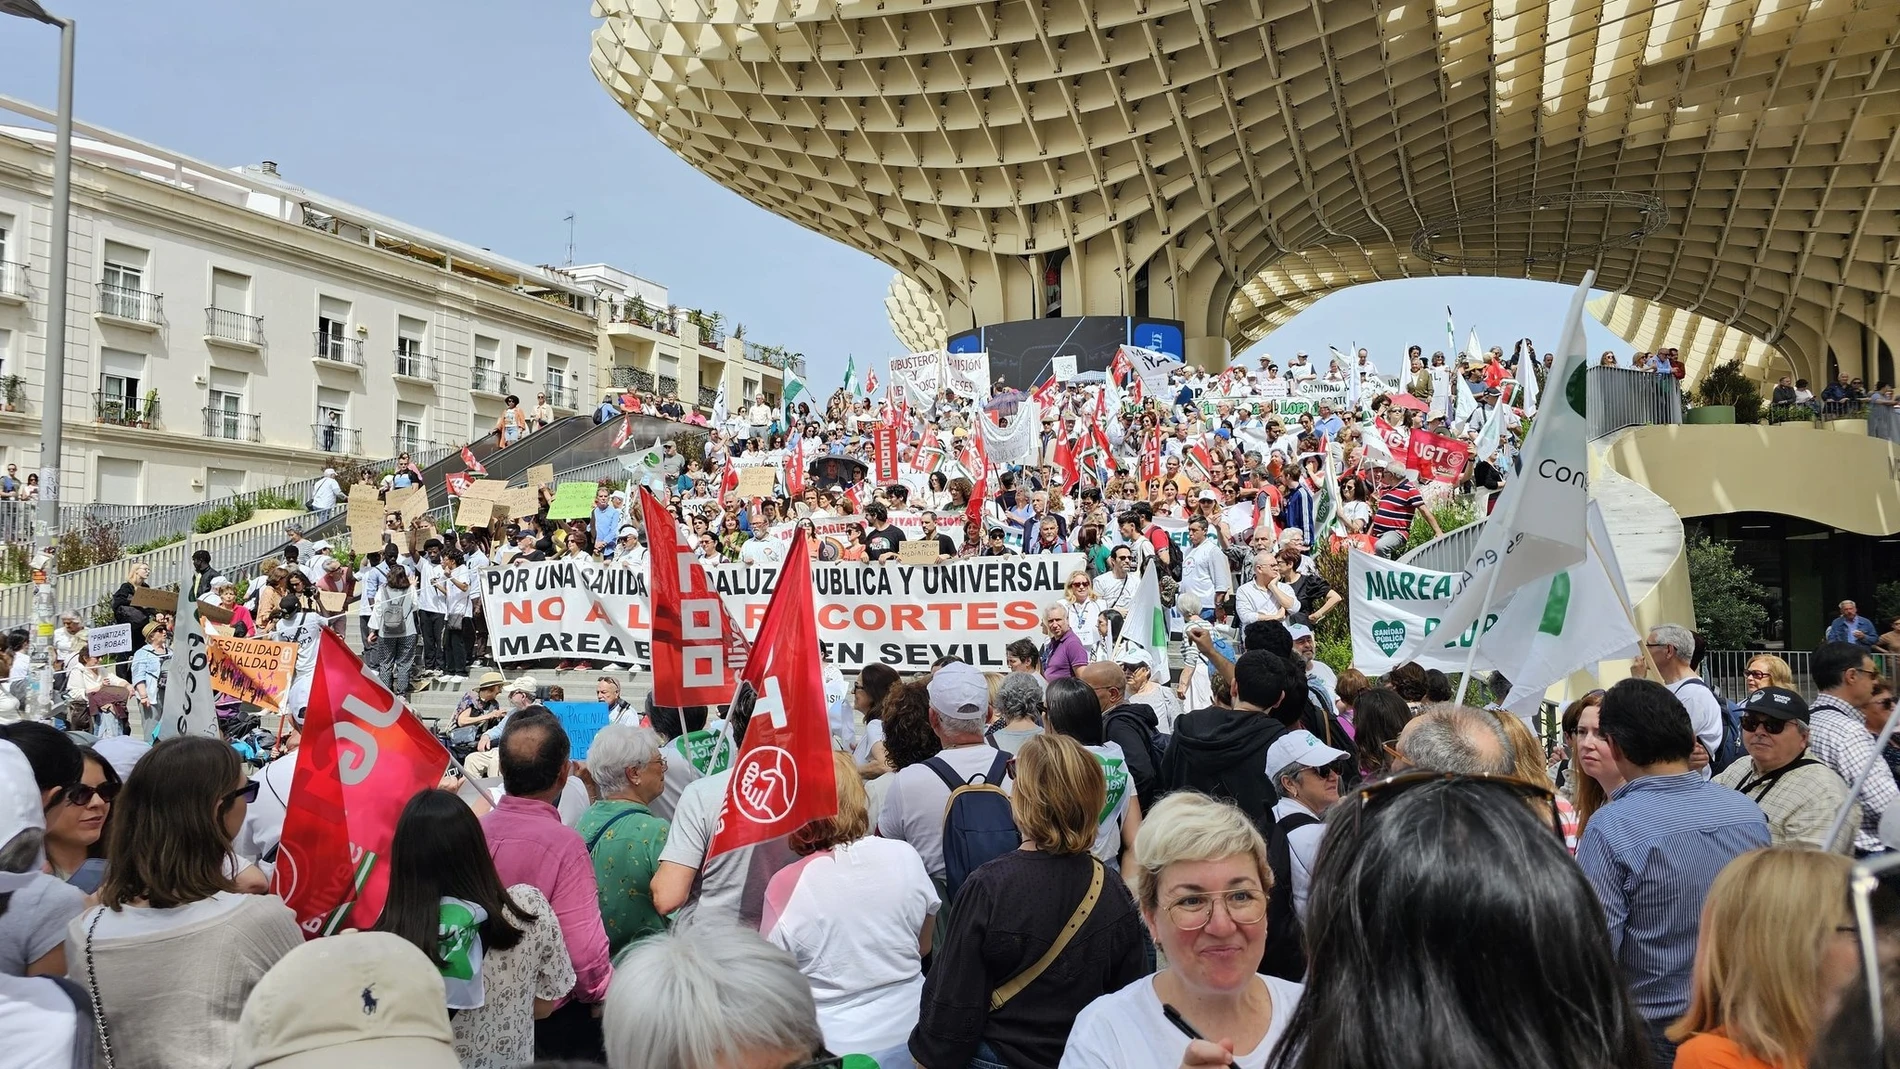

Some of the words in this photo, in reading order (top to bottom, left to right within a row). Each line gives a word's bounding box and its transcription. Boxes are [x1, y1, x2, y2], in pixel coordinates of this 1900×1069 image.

[1414, 441, 1449, 463] UGT
[488, 569, 530, 595] POR
[536, 561, 576, 591] UNA
[813, 567, 892, 595] UBLICA
[899, 566, 915, 595] Y
[922, 560, 1065, 595] UNIVERSAL
[1365, 570, 1451, 601] MAREA
[502, 596, 565, 626] NO
[585, 600, 613, 626] A
[745, 601, 1039, 631] RCORTES
[499, 632, 625, 657] MAREA
